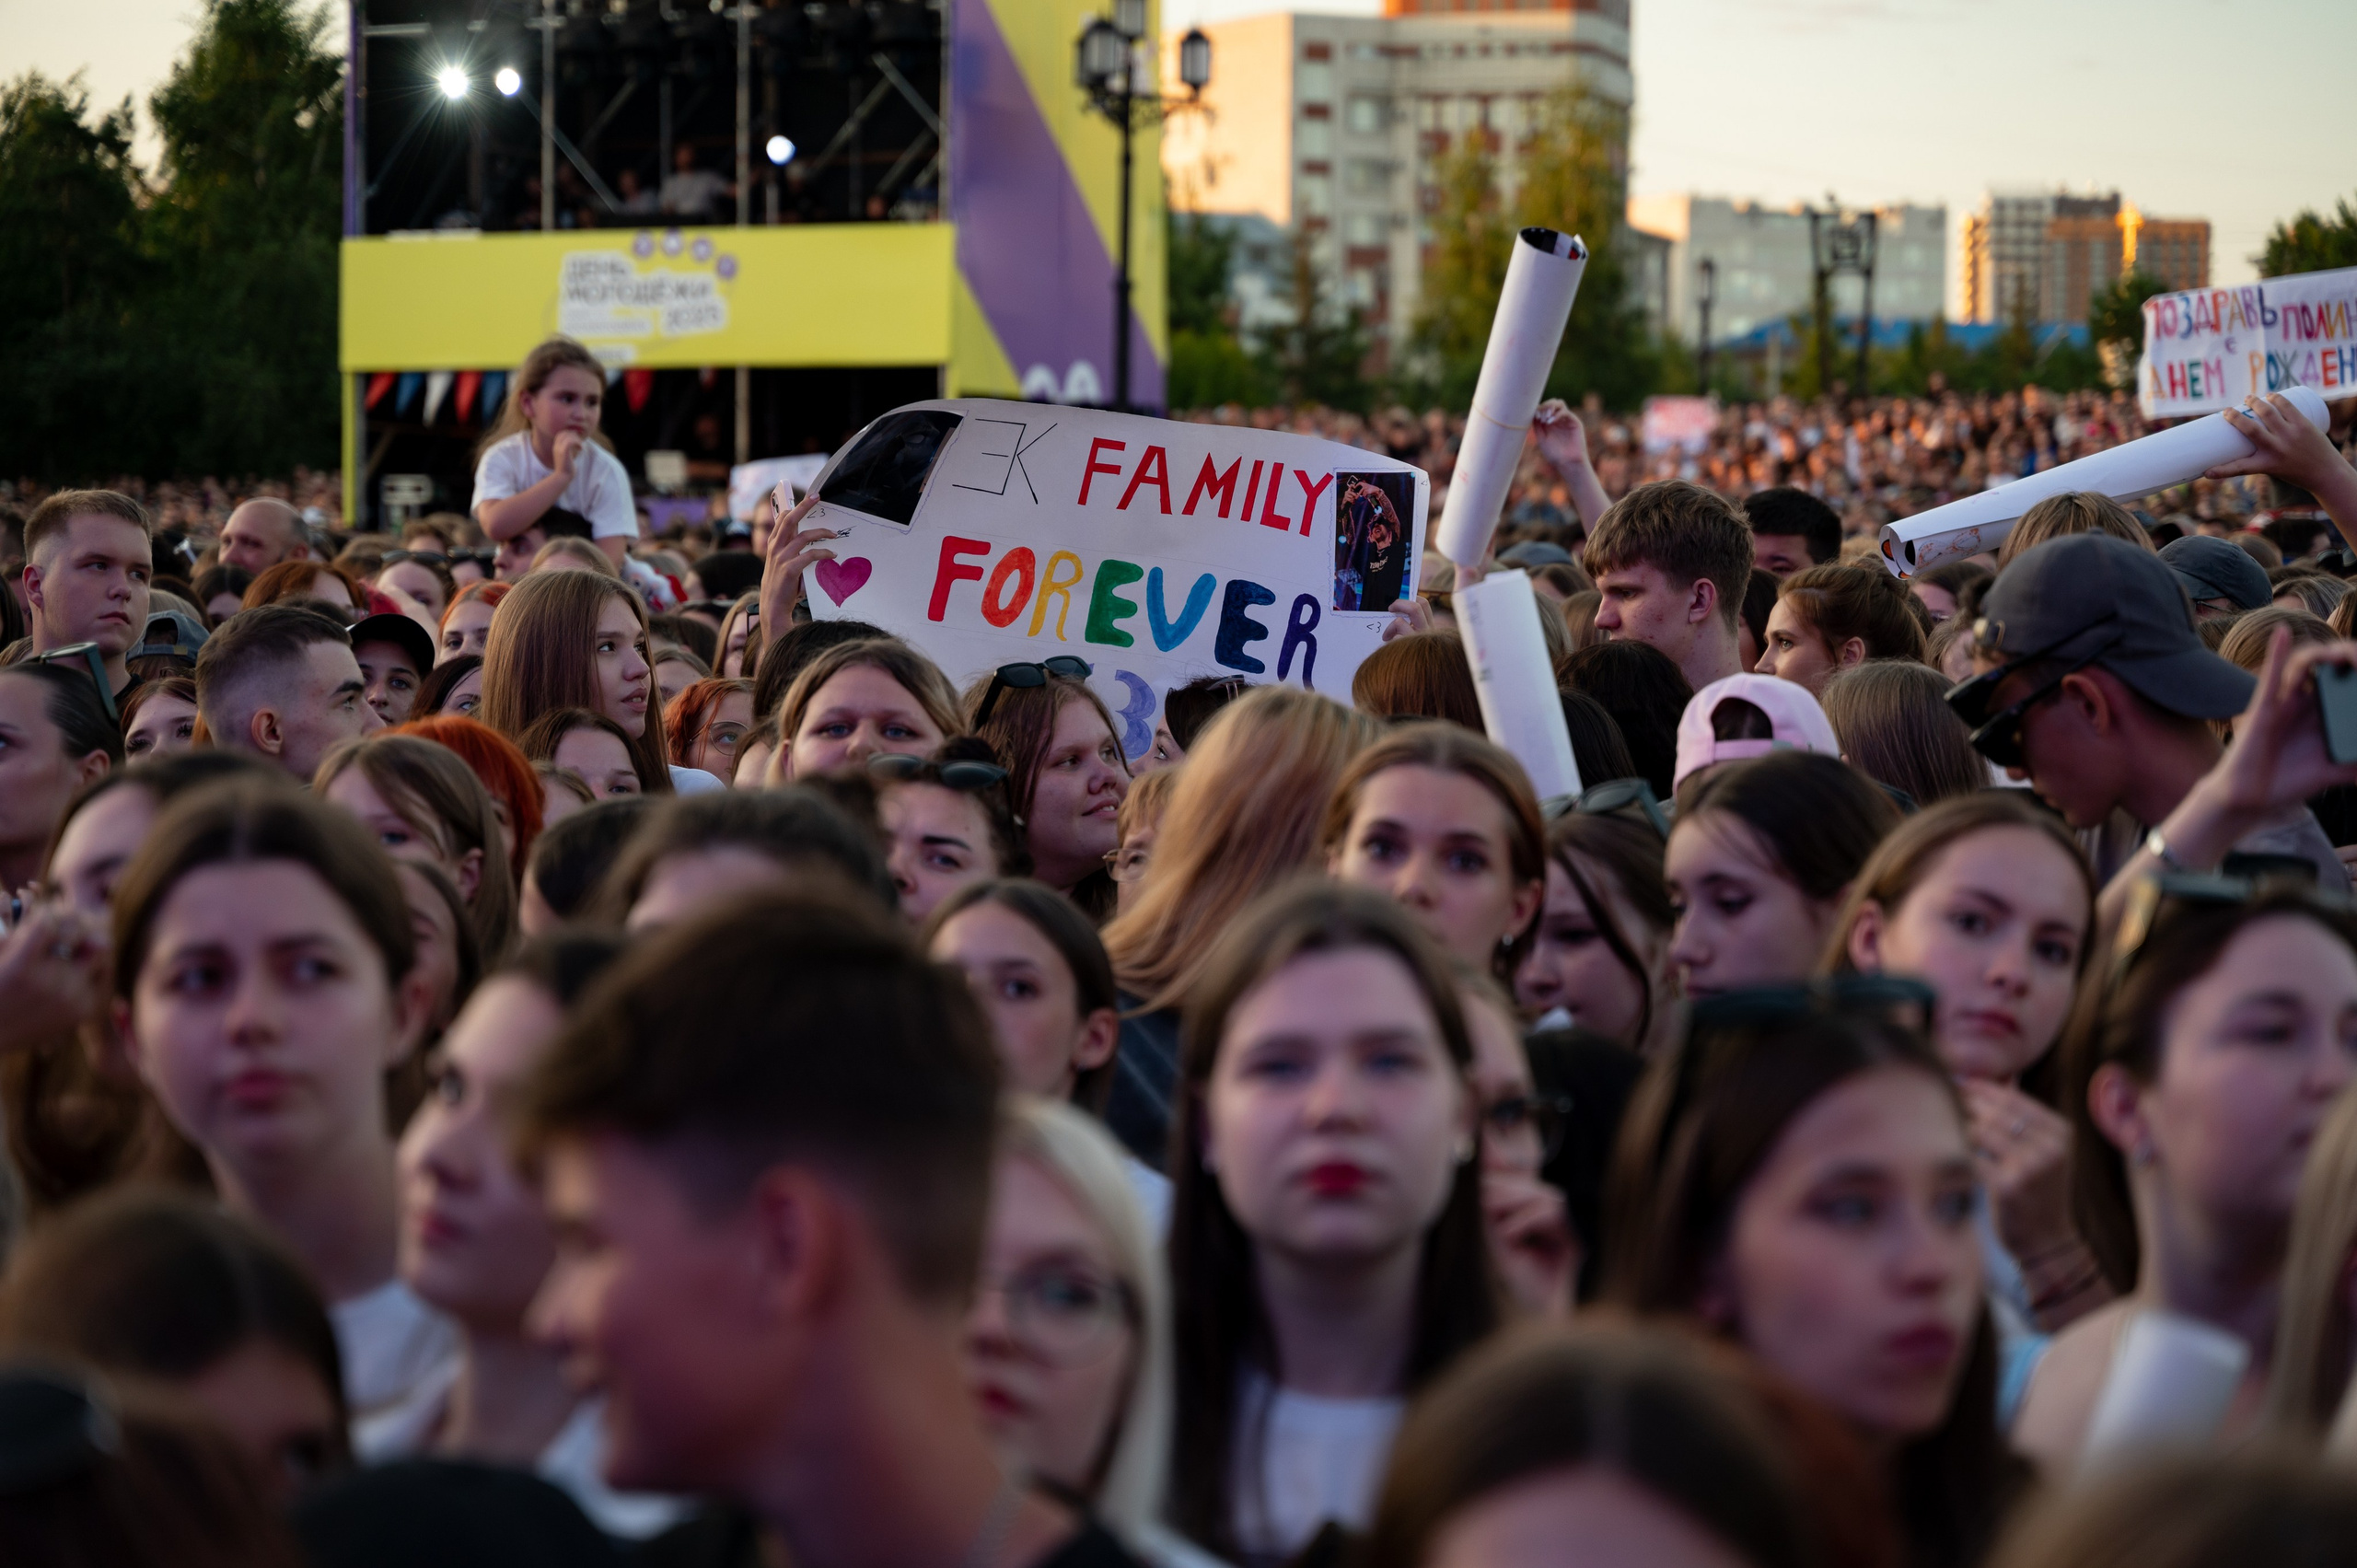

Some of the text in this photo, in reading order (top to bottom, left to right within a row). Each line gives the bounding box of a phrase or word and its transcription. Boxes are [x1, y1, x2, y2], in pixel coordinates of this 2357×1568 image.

[2144, 343, 2357, 401] ДНЕМ РОЖДЕН
[1077, 436, 1335, 538] FAMILY
[927, 535, 1322, 692] FOREVER
